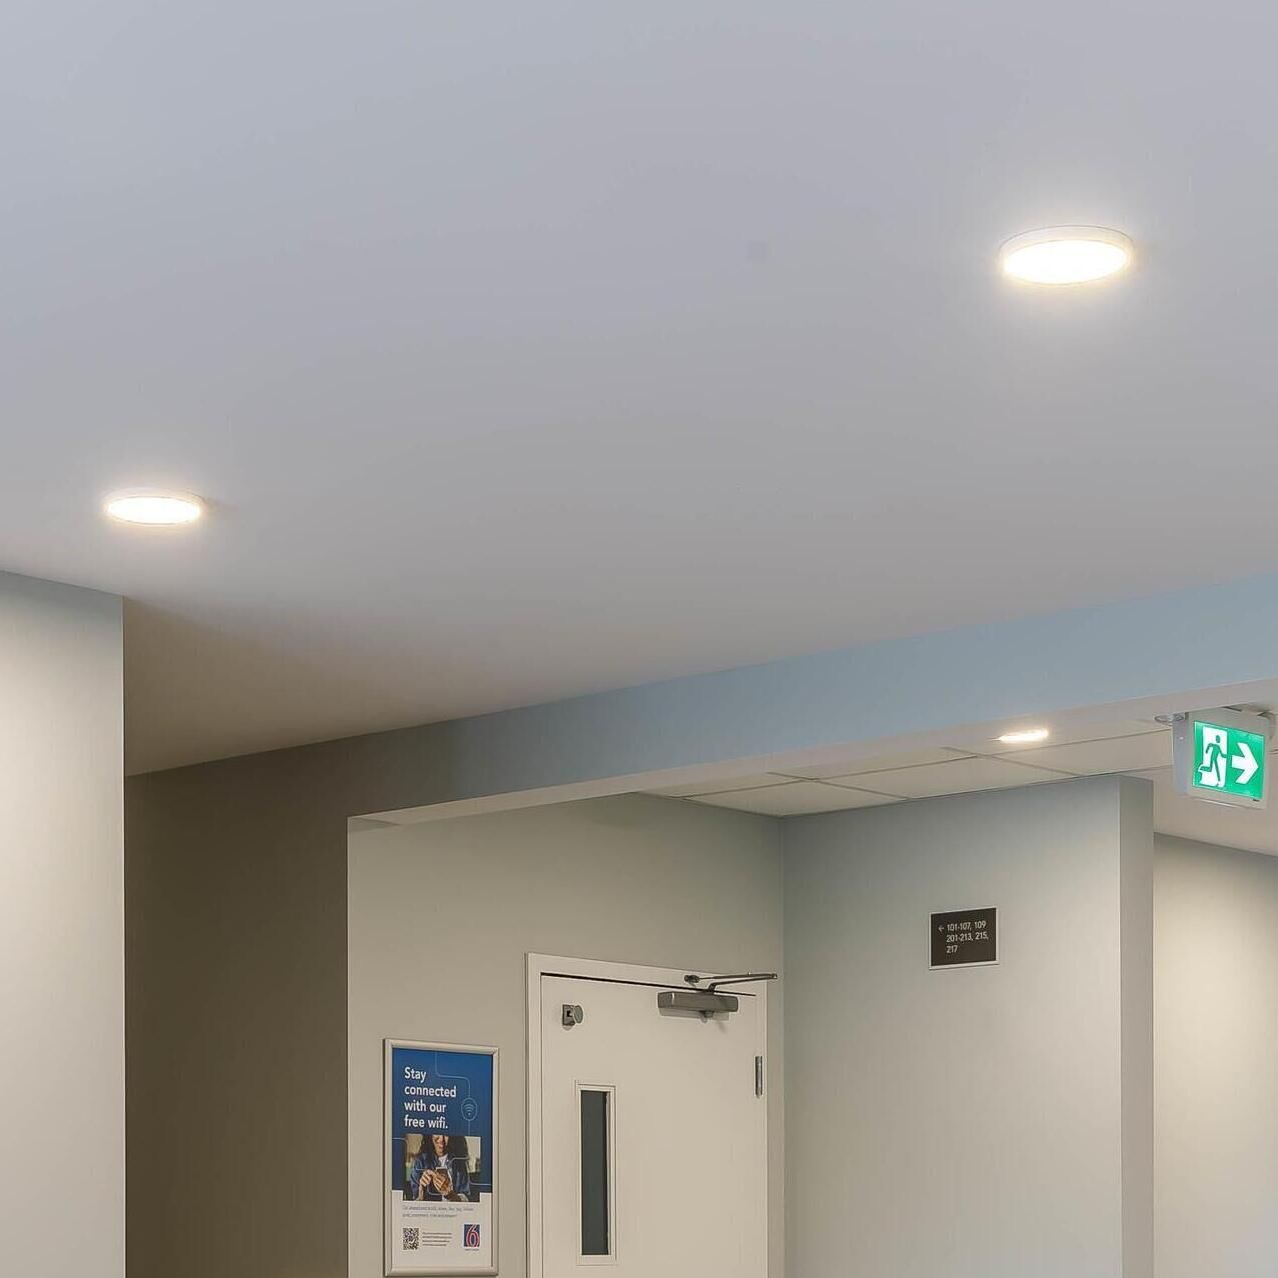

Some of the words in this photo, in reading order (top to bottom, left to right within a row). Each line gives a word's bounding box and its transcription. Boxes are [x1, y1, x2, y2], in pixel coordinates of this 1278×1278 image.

[947, 922, 971, 931] 101-107,
[946, 933, 973, 942] 201-213,
[946, 945, 958, 954] 217
[404, 1066, 427, 1083] Stay
[404, 1085, 457, 1098] connected
[404, 1099, 427, 1112] with
[429, 1103, 447, 1113] our
[404, 1114, 425, 1127] free
[427, 1116, 449, 1129] wifi.
[466, 1224, 479, 1247] 6
